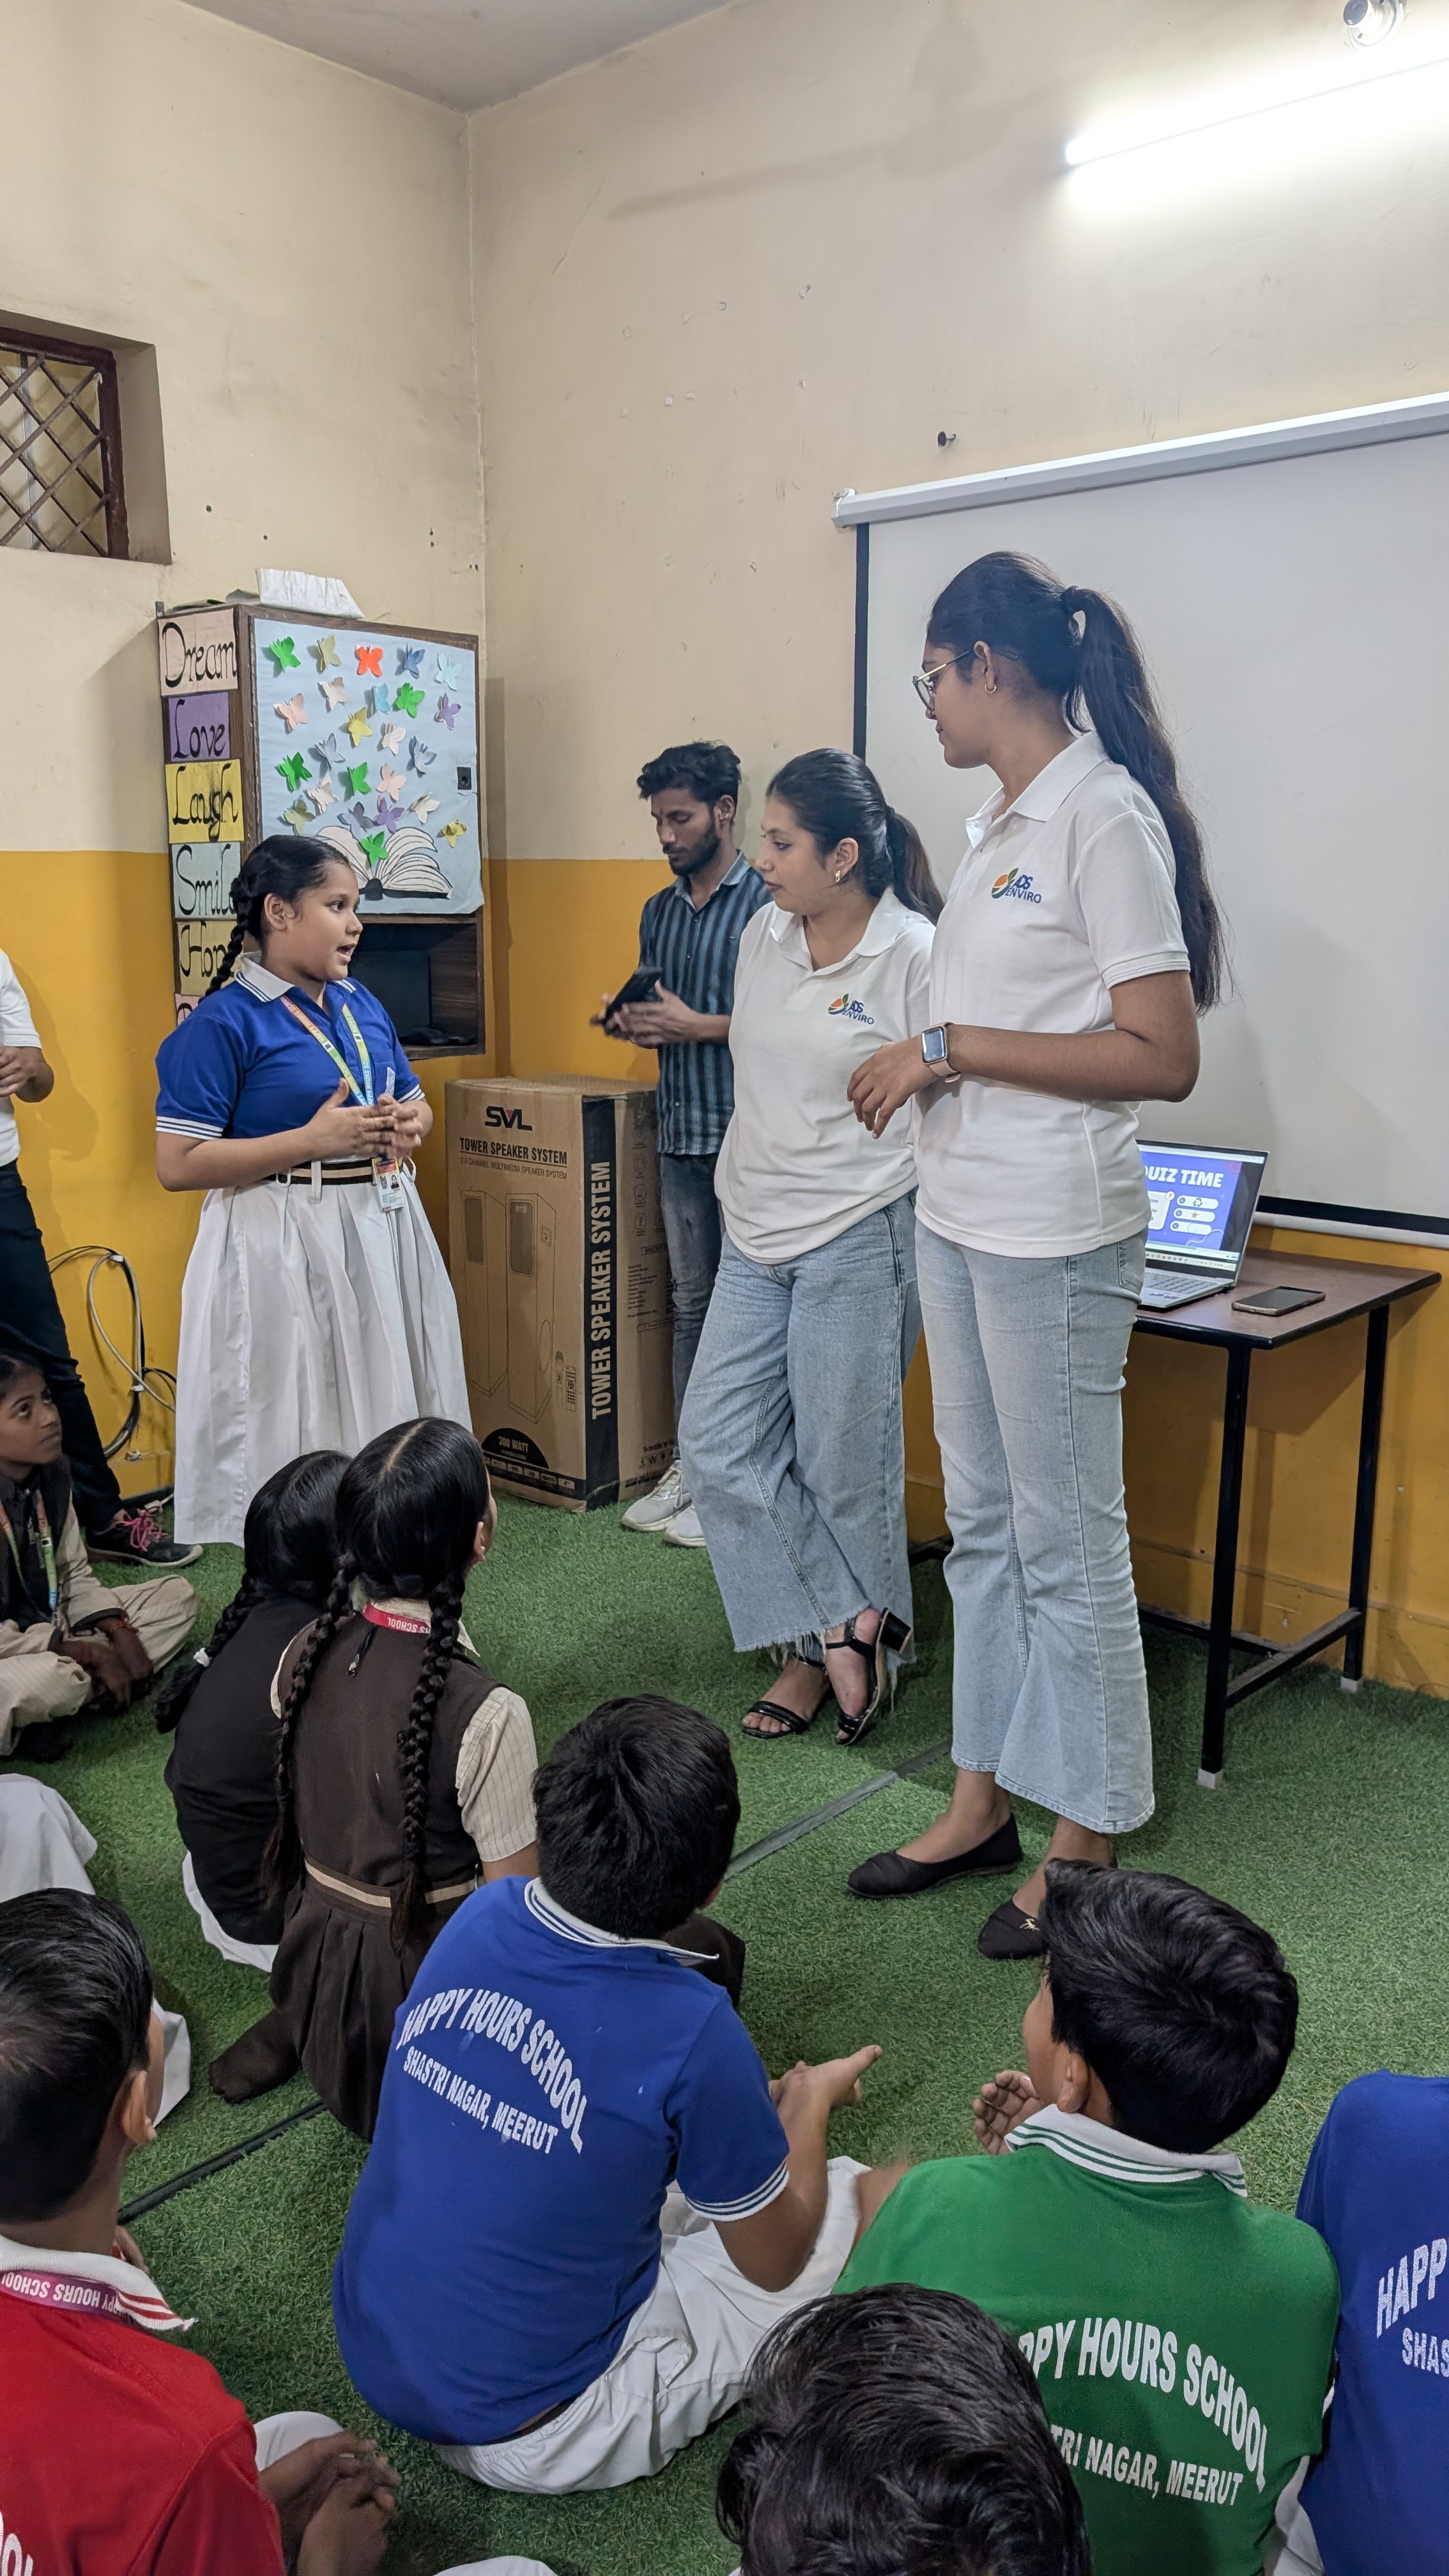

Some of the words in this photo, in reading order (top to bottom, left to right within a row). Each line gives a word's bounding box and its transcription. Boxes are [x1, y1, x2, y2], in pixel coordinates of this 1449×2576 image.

[162, 622, 237, 688] Dream
[173, 698, 226, 759] Love
[172, 762, 238, 842] Laugh
[1005, 888, 1041, 903] ENVIRO
[180, 920, 227, 977] Hop
[841, 1010, 875, 1024] ENVIRO
[484, 1105, 533, 1131] SVL
[459, 1137, 488, 1154] TOWER
[491, 1141, 529, 1160] SPEAKER
[532, 1147, 567, 1165] SYSTEM
[468, 1158, 490, 1169] CHANNEL
[491, 1162, 521, 1174] MULTIMEDIA
[521, 1166, 545, 1177] SPEAKER
[546, 1170, 567, 1179] SYSTEM
[1144, 1165, 1178, 1183] UIZ
[1181, 1169, 1224, 1188] TIME
[590, 1161, 611, 1245] SYSTEM
[591, 1248, 611, 1344] SPEAKER
[592, 1346, 612, 1420] TOWER
[498, 1436, 510, 1448] 300
[511, 1439, 529, 1453] WATT
[387, 1616, 418, 1634] SCHOOL
[395, 1988, 473, 2051] HAPPY
[460, 1989, 533, 2052] HOURS
[521, 2019, 588, 2154] SCHOOL
[403, 2046, 452, 2096] SHASTRI
[446, 2074, 492, 2130] NAGAR,
[491, 2101, 559, 2154] MEERUT
[53, 2283, 101, 2308] HOURS
[1376, 2237, 1449, 2339] HAPP
[1402, 2327, 1449, 2378] SHAS
[1018, 2319, 1076, 2379] PPY
[1077, 2317, 1178, 2393] HOURS
[1183, 2343, 1268, 2493] SCHOOL
[1085, 2436, 1160, 2499] NAGAR,
[1165, 2460, 1244, 2506] MEERUT
